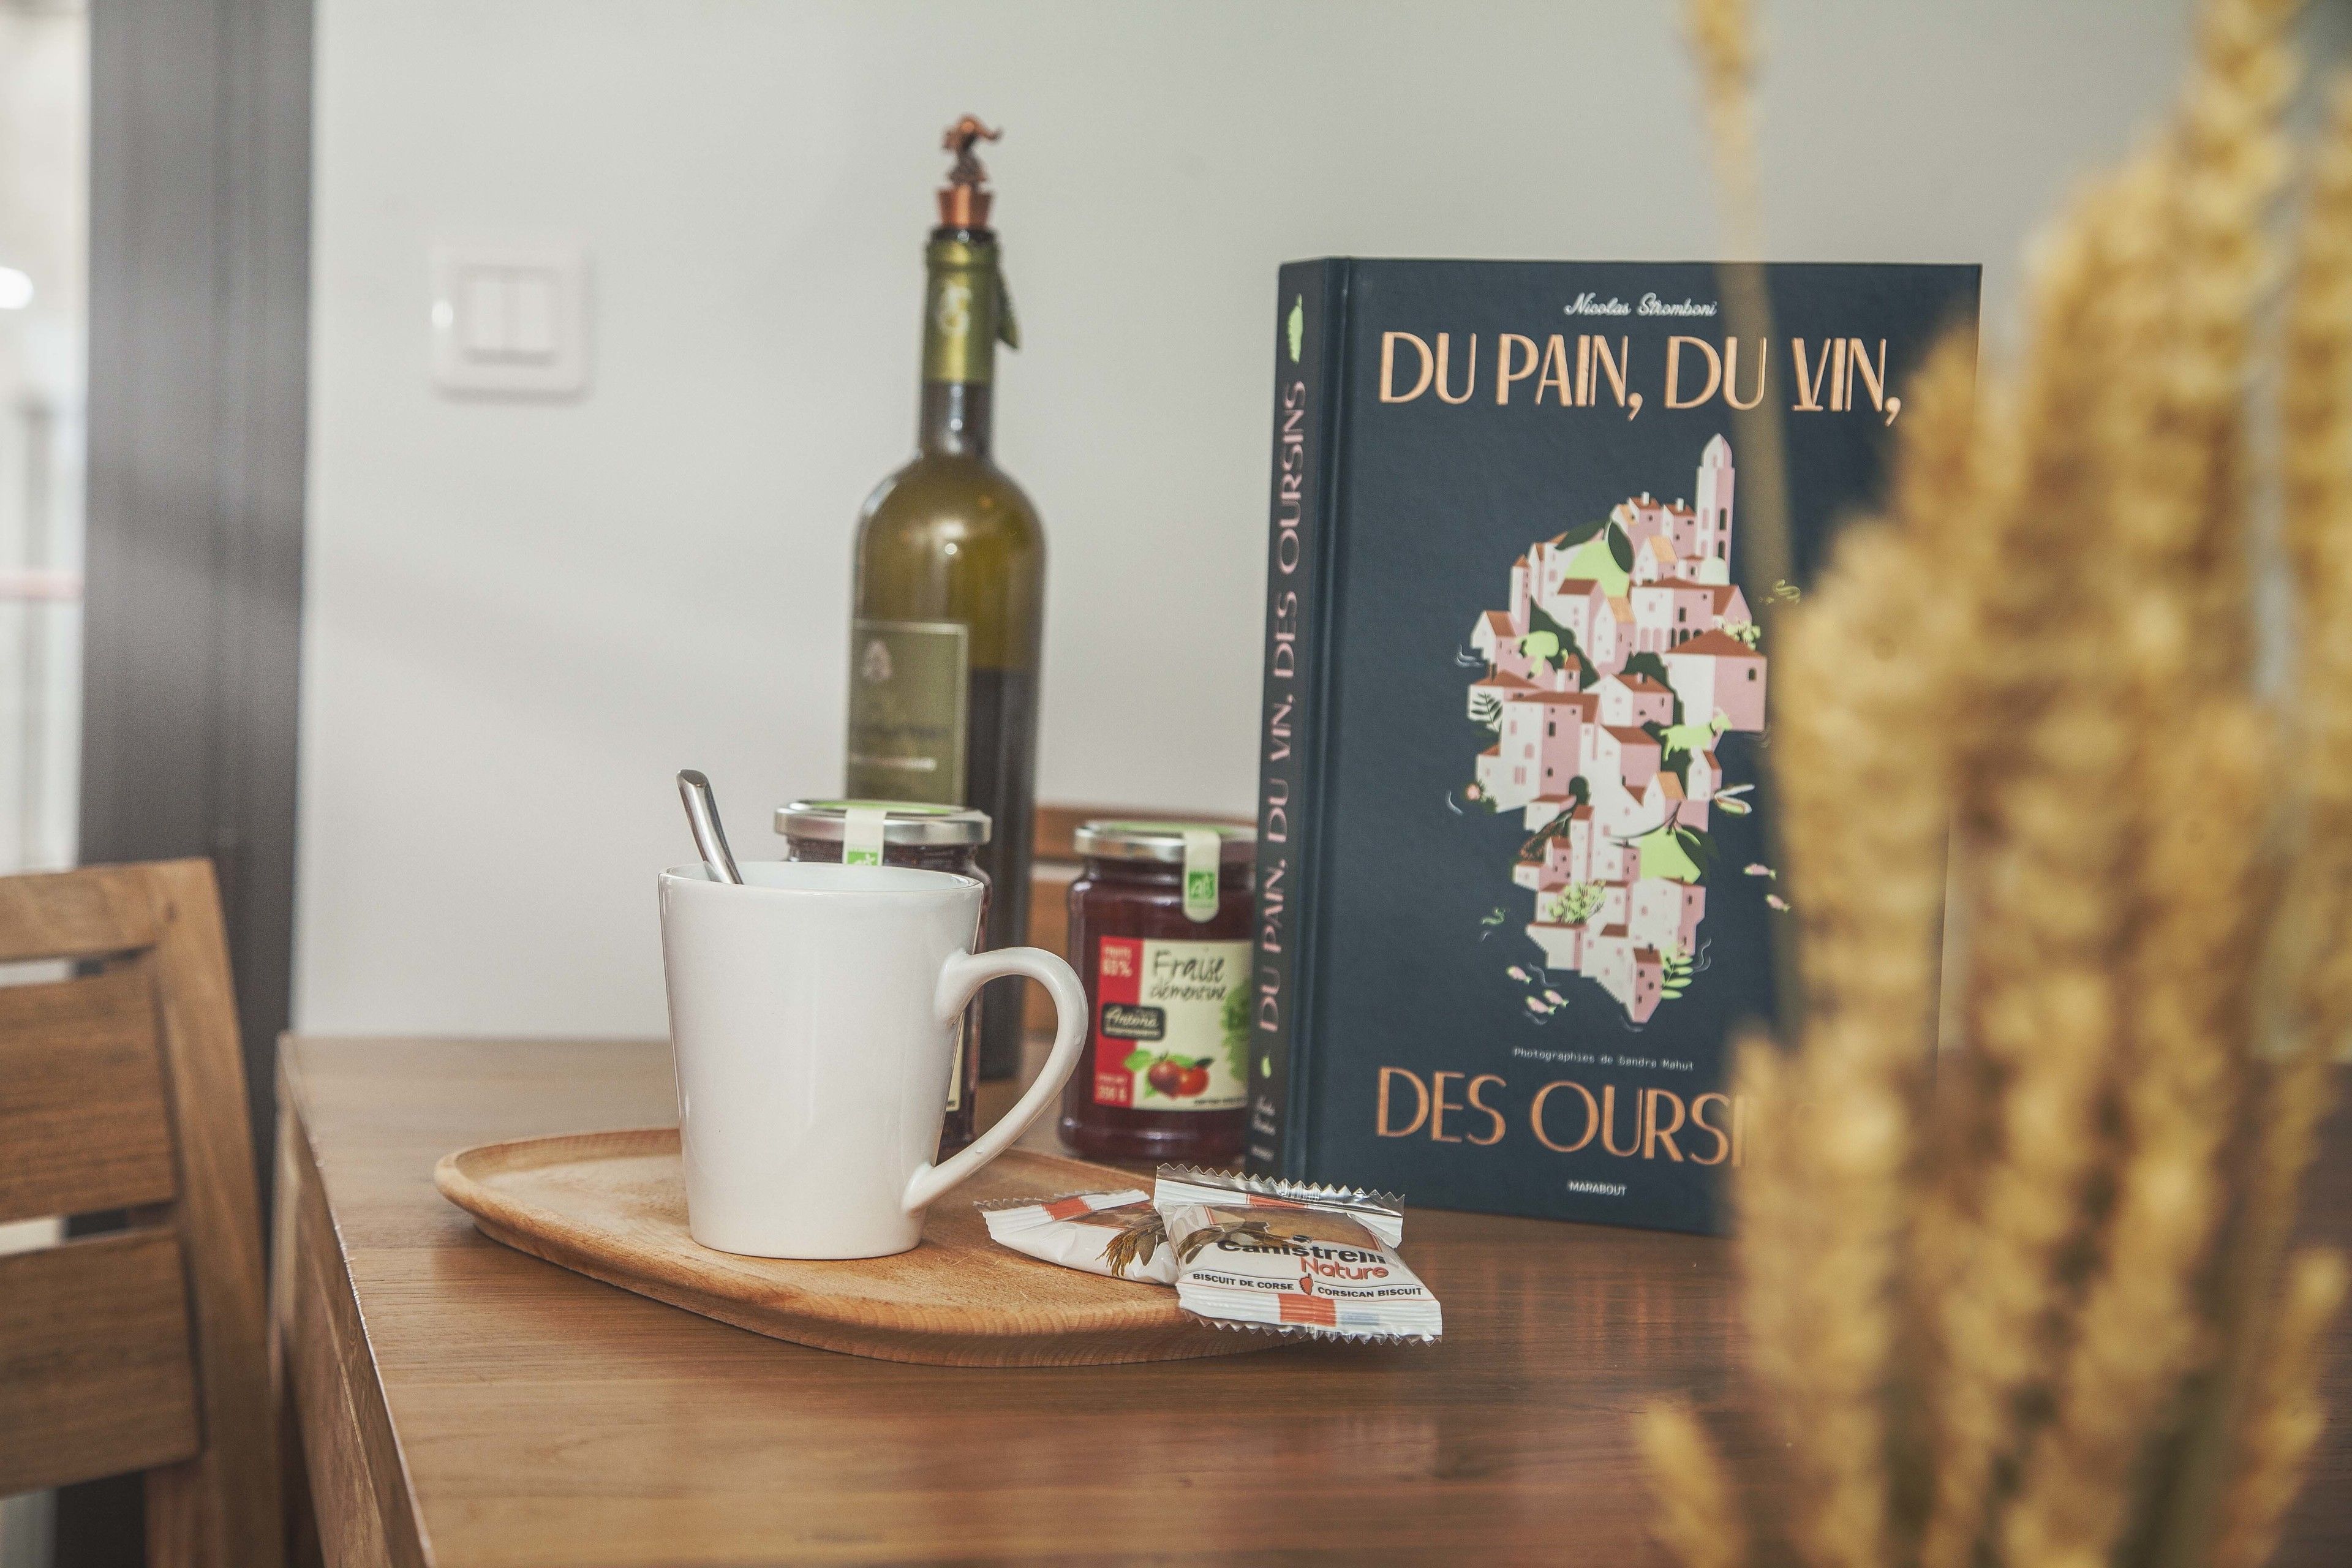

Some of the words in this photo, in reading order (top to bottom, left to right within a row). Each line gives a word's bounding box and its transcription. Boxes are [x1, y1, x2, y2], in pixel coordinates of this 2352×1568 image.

[1564, 292, 1631, 315] Nicolas
[1637, 292, 1717, 316] Stromboni
[1379, 331, 1477, 405] DU
[1496, 333, 1643, 421] PAIN,
[1665, 336, 1766, 410] DU
[1791, 337, 1901, 427] VIN,
[1278, 380, 1306, 575] OURSINS
[1273, 591, 1297, 677] DES
[1267, 778, 1289, 843] DU
[1259, 967, 1280, 1032] DU
[1514, 1046, 1595, 1063] Photographies
[1600, 1054, 1613, 1065] de
[1619, 1055, 1657, 1069] Sandra
[1661, 1058, 1694, 1072] Mahut
[1376, 1066, 1507, 1145] DES
[1532, 1080, 1744, 1167] OURSI
[1567, 1180, 1627, 1196] MARABOUT
[1193, 1273, 1235, 1286] BISCUIT
[1257, 1281, 1294, 1291] CORSE
[1317, 1287, 1374, 1298] CORSICAN
[1378, 1287, 1423, 1297] BISCUIT
[1300, 1256, 1389, 1281] Nature
